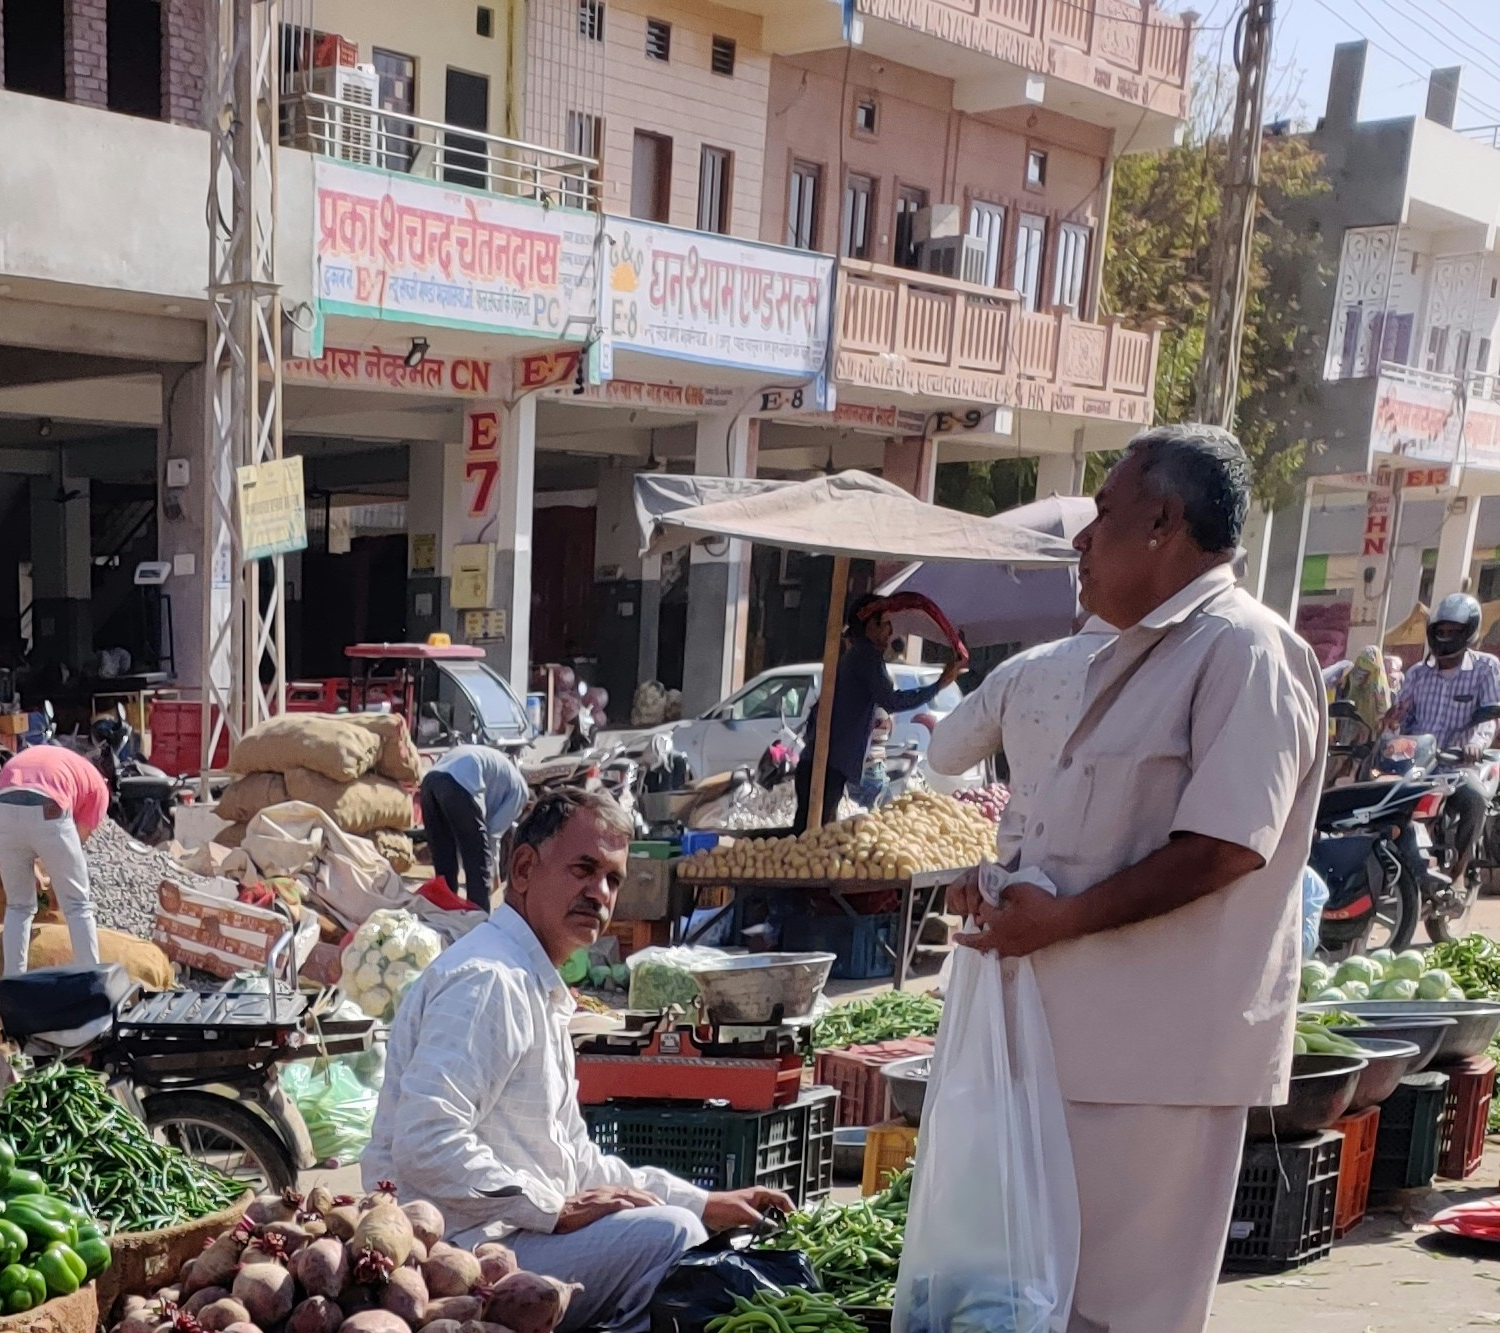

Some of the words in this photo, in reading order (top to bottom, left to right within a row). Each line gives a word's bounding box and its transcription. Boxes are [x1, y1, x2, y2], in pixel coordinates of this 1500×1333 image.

[455, 197, 561, 291] चेतनदास
[649, 245, 737, 328] घनश्याम
[451, 359, 491, 393] CN
[469, 412, 499, 451] E
[466, 461, 498, 512] 7
[1366, 515, 1387, 534] H
[1363, 537, 1386, 556] N
